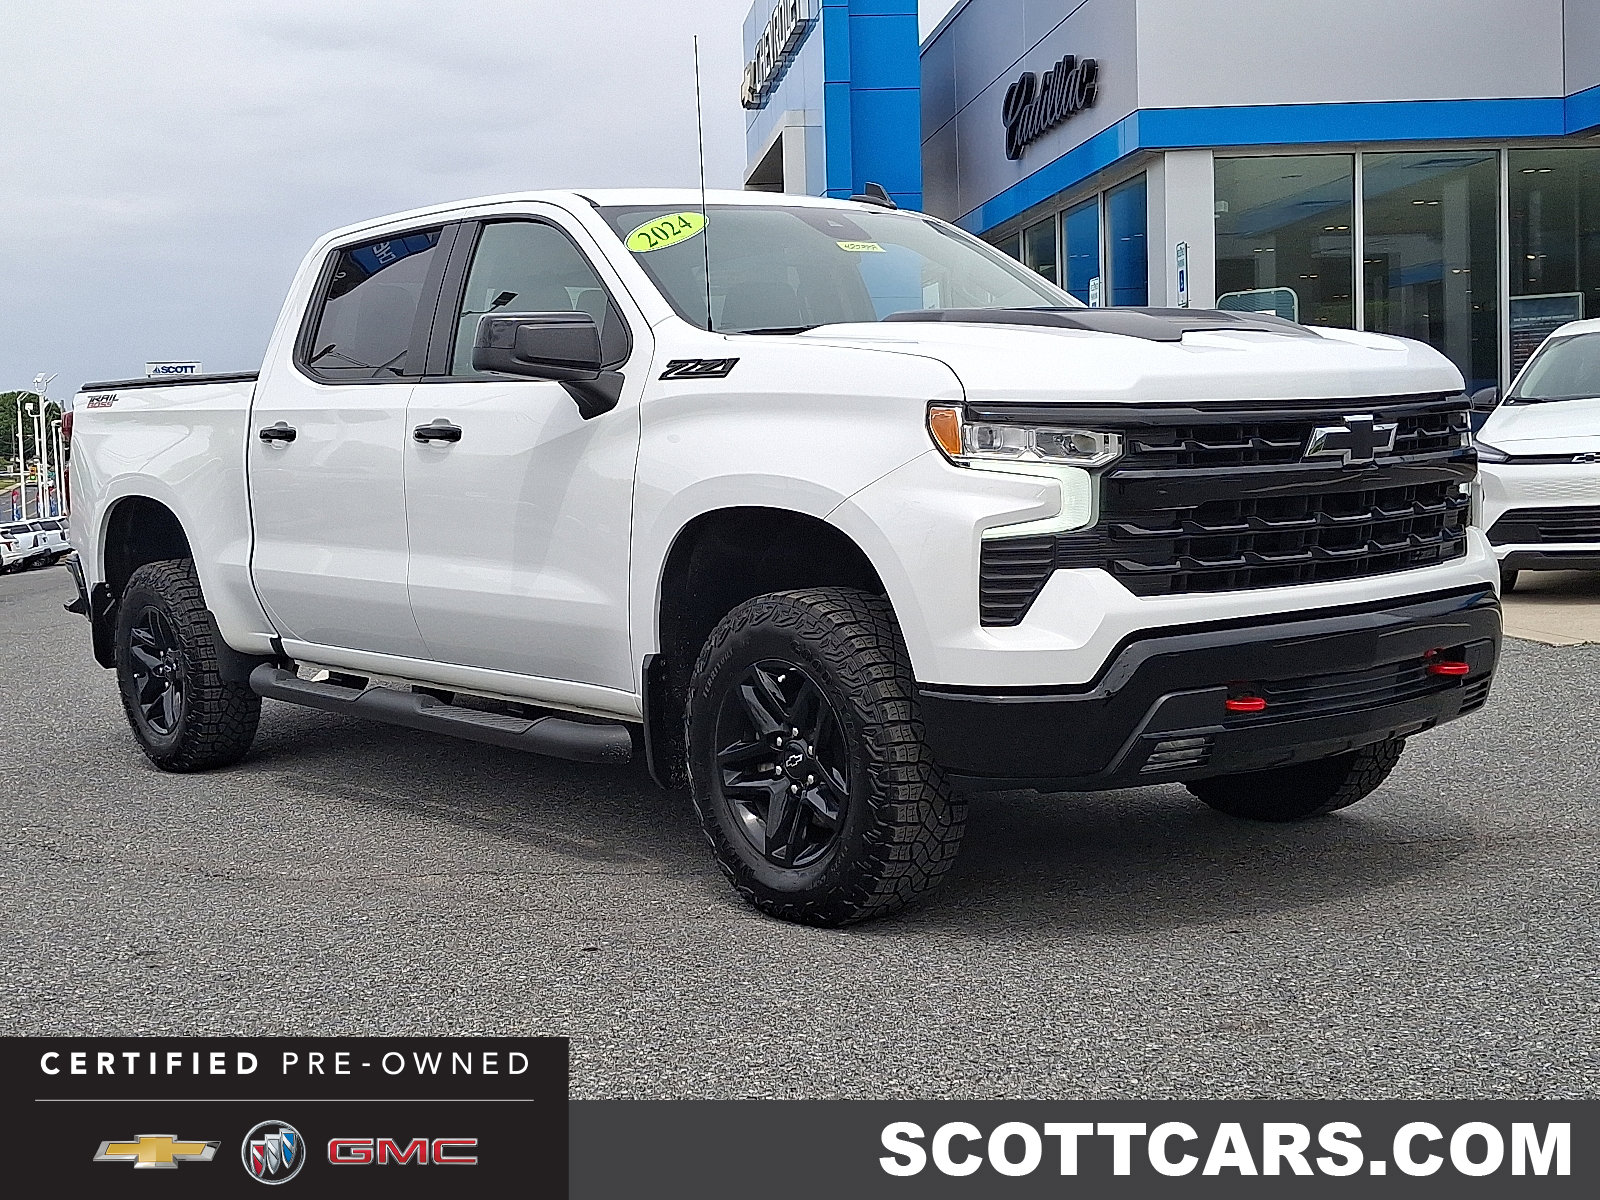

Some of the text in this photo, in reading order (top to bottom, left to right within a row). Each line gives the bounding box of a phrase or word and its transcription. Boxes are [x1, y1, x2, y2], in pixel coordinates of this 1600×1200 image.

[1002, 54, 1097, 160] Cadillac
[637, 215, 692, 247] 2024
[161, 365, 196, 374] SCOTT
[88, 394, 120, 403] TRAIL
